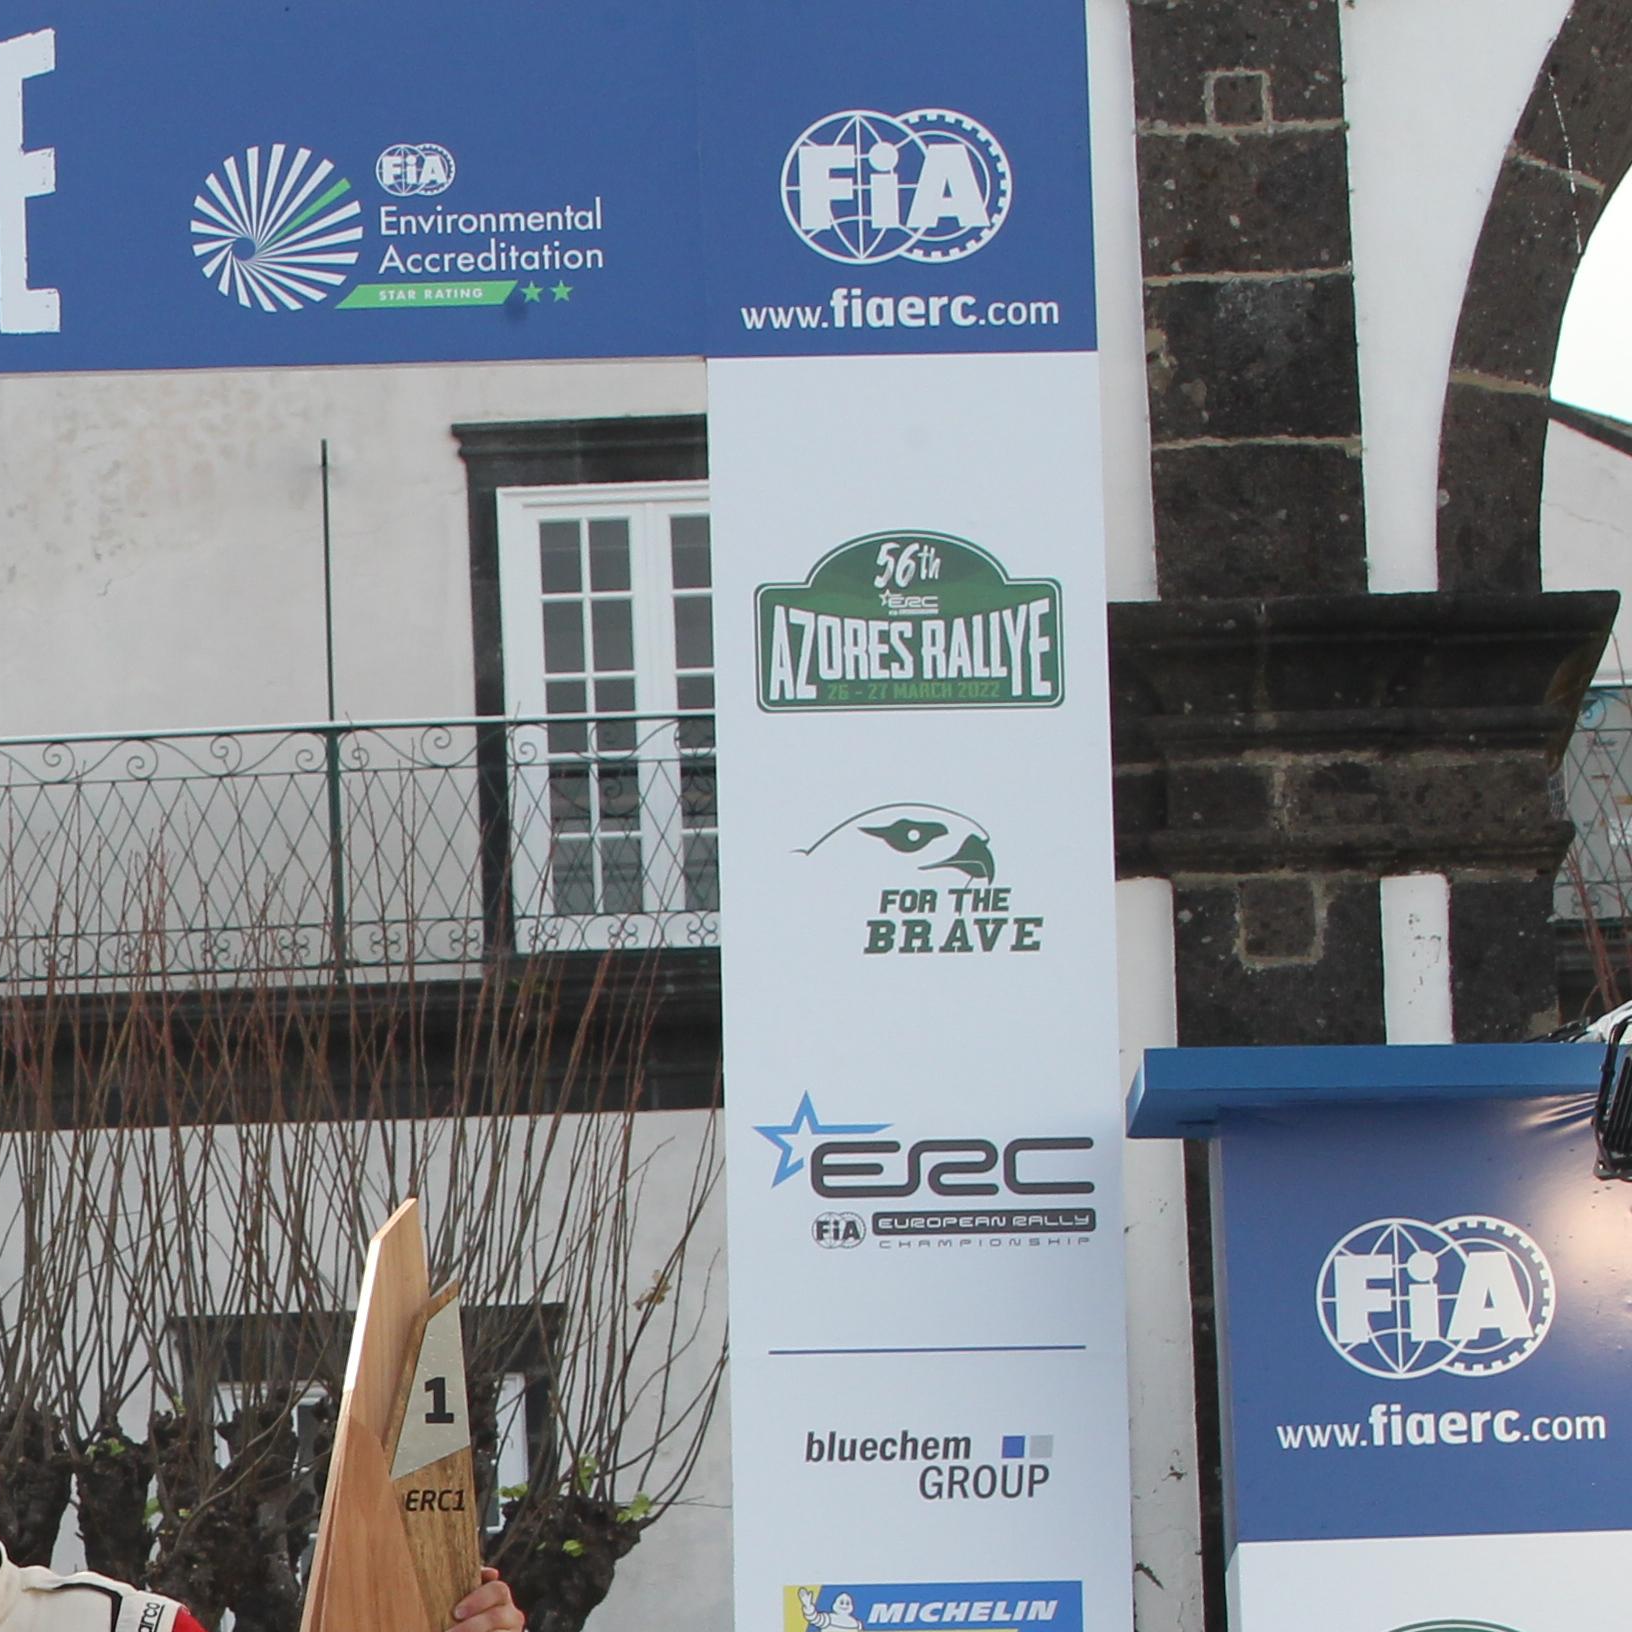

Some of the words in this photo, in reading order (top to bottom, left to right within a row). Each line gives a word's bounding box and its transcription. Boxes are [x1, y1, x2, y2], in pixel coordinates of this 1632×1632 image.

[379, 197, 602, 235] Environmental
[378, 239, 603, 274] Accreditation
[379, 290, 416, 301] STAR
[424, 288, 483, 300] RATING
[741, 288, 1060, 330] www.fiaerc.com
[874, 542, 941, 588] 56th
[770, 605, 914, 700] AZORES
[922, 598, 1051, 697] RALLYE
[880, 889, 937, 913] FOR
[948, 887, 1011, 914] THE
[864, 917, 1043, 954] BRAVE
[810, 1137, 1095, 1198] ERC
[878, 1215, 1006, 1230] EUROPEAN
[1013, 1214, 1089, 1228] RALLY
[879, 1237, 1090, 1249] CHAMPIONSHIP
[424, 1376, 455, 1424] 1
[1277, 1404, 1606, 1449] www.fiaerc.com
[805, 1430, 971, 1462] bluechem
[919, 1464, 1050, 1500] GROUP
[404, 1489, 466, 1512] ERC1
[867, 1599, 1058, 1624] MICHELIN
